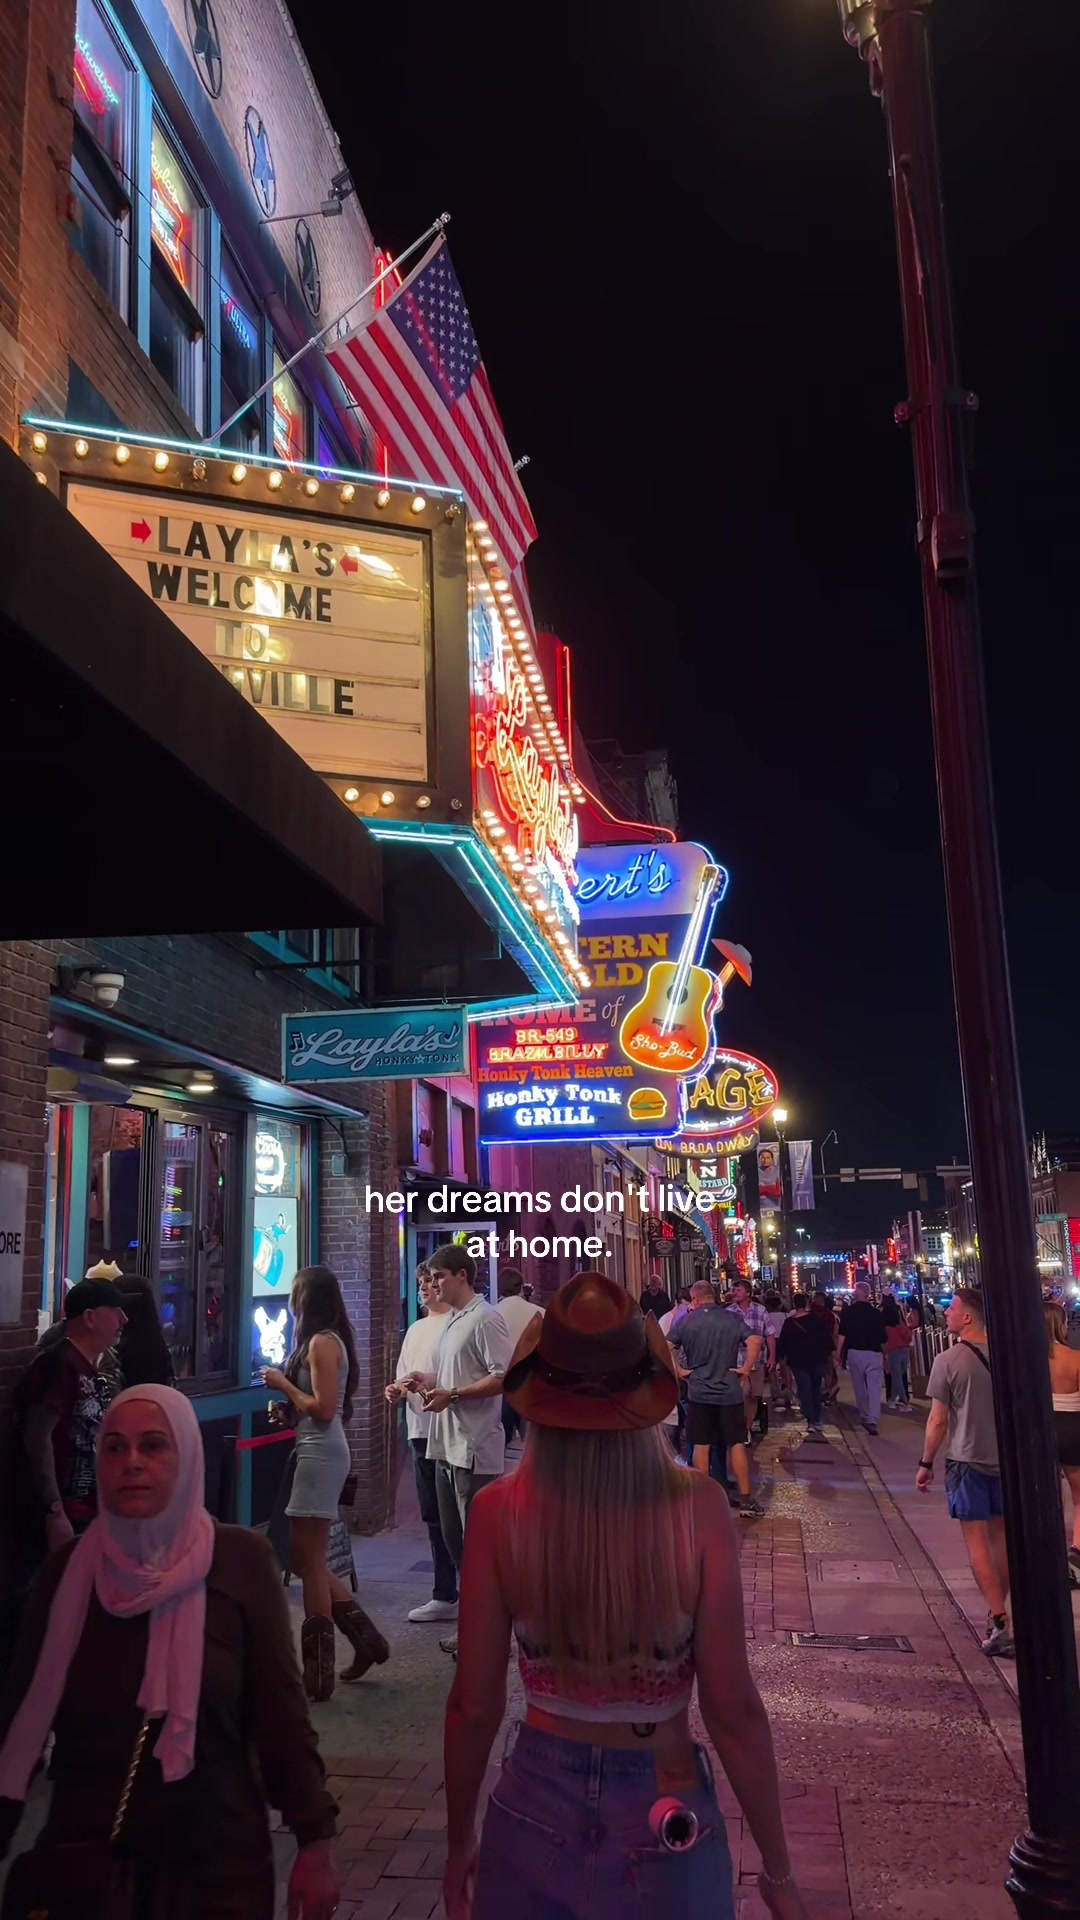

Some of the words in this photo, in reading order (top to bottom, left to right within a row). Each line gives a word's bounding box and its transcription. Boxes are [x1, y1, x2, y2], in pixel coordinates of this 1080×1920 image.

[158, 516, 334, 577] LAYLA'S
[147, 561, 332, 623] WELCOME
[216, 621, 267, 659] TO
[586, 963, 644, 987] LD
[481, 999, 597, 1026] HOME
[601, 995, 626, 1027] of
[291, 1022, 458, 1072] Layla's
[375, 1056, 416, 1067] HONKY
[424, 1053, 460, 1064] TONK
[478, 1067, 529, 1085] Honky
[531, 1064, 570, 1080] Tonk
[574, 1064, 634, 1079] Heaven
[487, 1085, 558, 1109] Honky
[564, 1084, 622, 1105] Tonk
[515, 1106, 595, 1126] GRILL
[680, 1134, 755, 1154] BROADWAY
[699, 1177, 728, 1188] STARD
